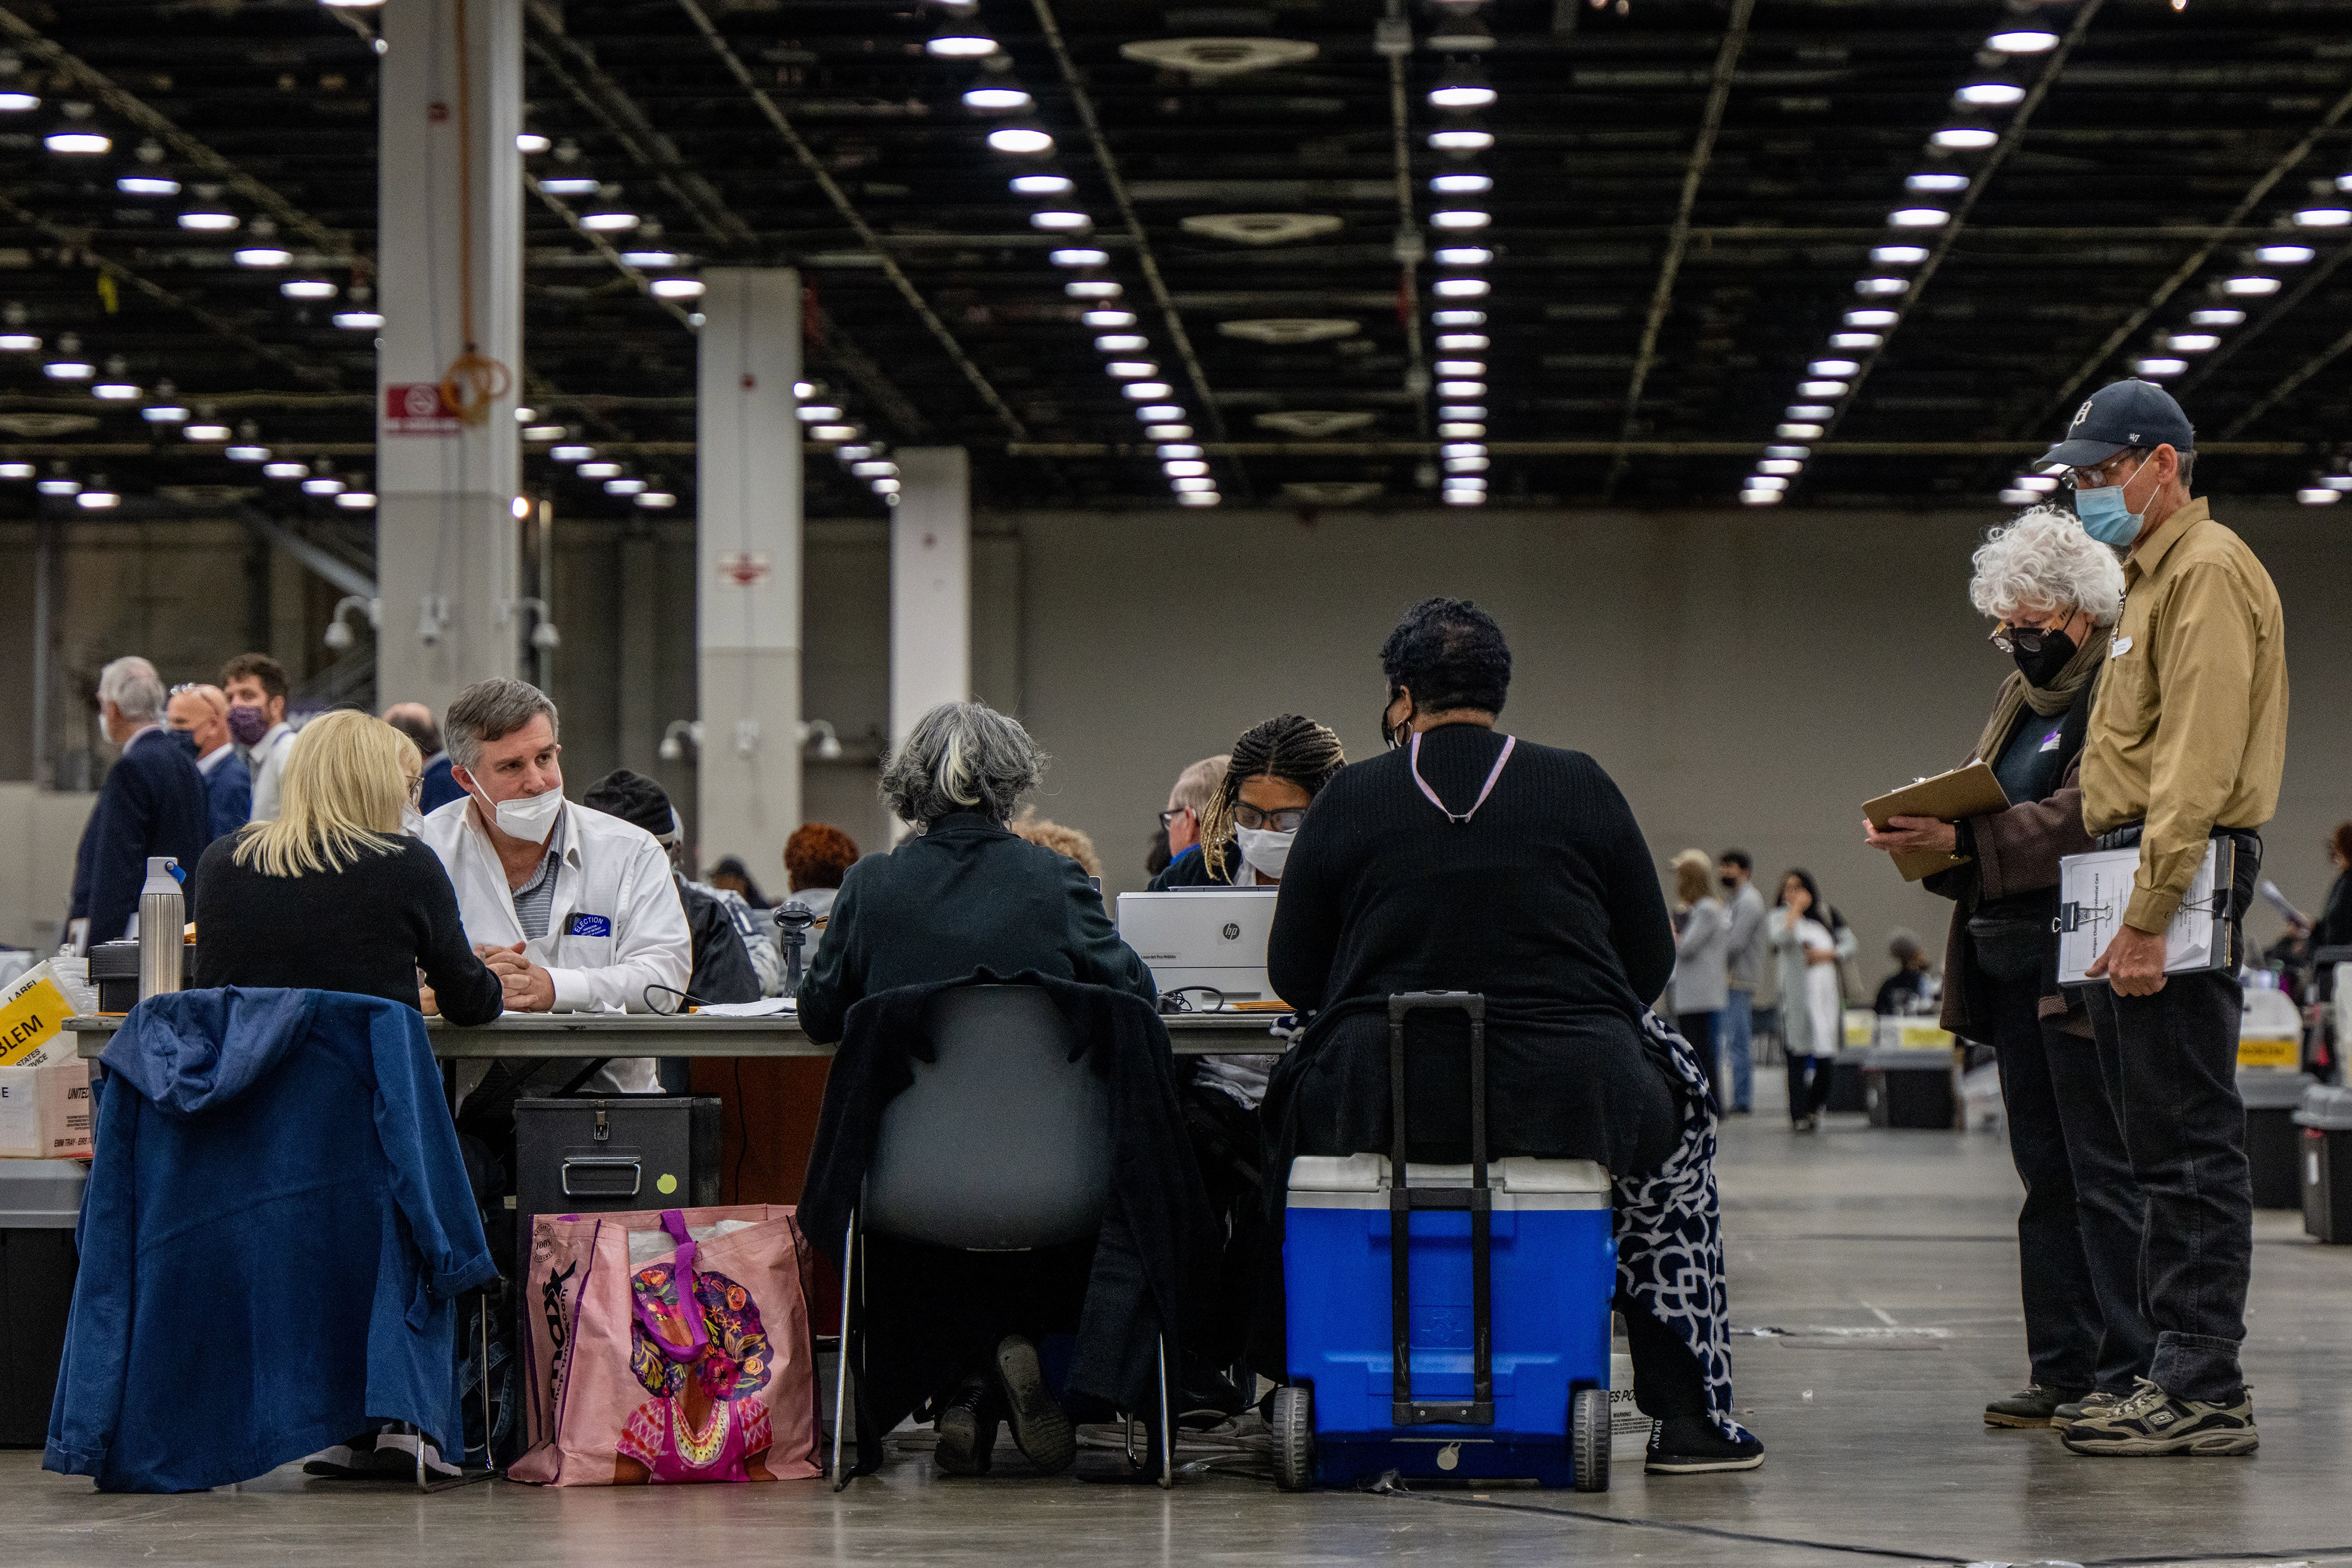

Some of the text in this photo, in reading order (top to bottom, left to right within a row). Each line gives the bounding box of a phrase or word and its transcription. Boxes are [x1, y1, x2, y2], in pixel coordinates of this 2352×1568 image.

[574, 917, 604, 933] ELECTION
[1224, 923, 1239, 940] hp
[16, 1048, 41, 1067] STATES
[27, 1053, 48, 1067] RVICE
[67, 1087, 89, 1100] UNITED
[64, 1138, 75, 1147] TRAY
[536, 1237, 552, 1250] 100%
[554, 1373, 563, 1409] shop
[1609, 1389, 1636, 1403] ES PO
[1651, 1420, 1663, 1449] DKNY
